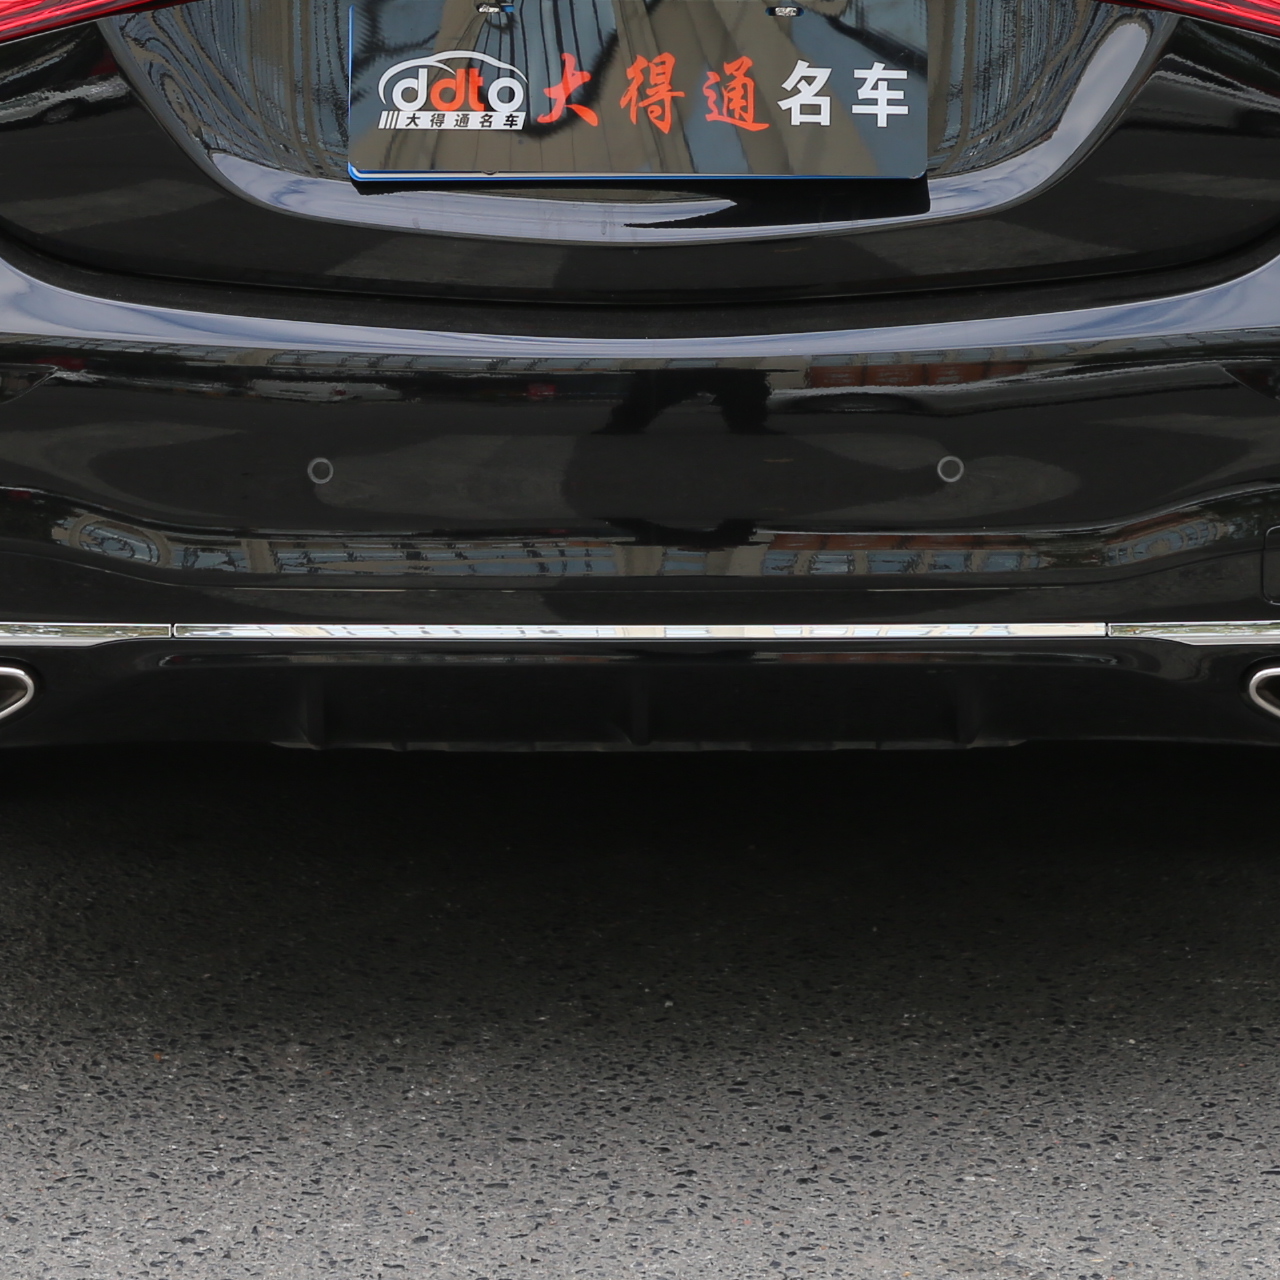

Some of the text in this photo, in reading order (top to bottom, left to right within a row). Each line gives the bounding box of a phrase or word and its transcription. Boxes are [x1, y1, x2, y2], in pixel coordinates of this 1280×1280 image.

[392, 68, 524, 112] ddto
[405, 113, 520, 128] 大得通名车
